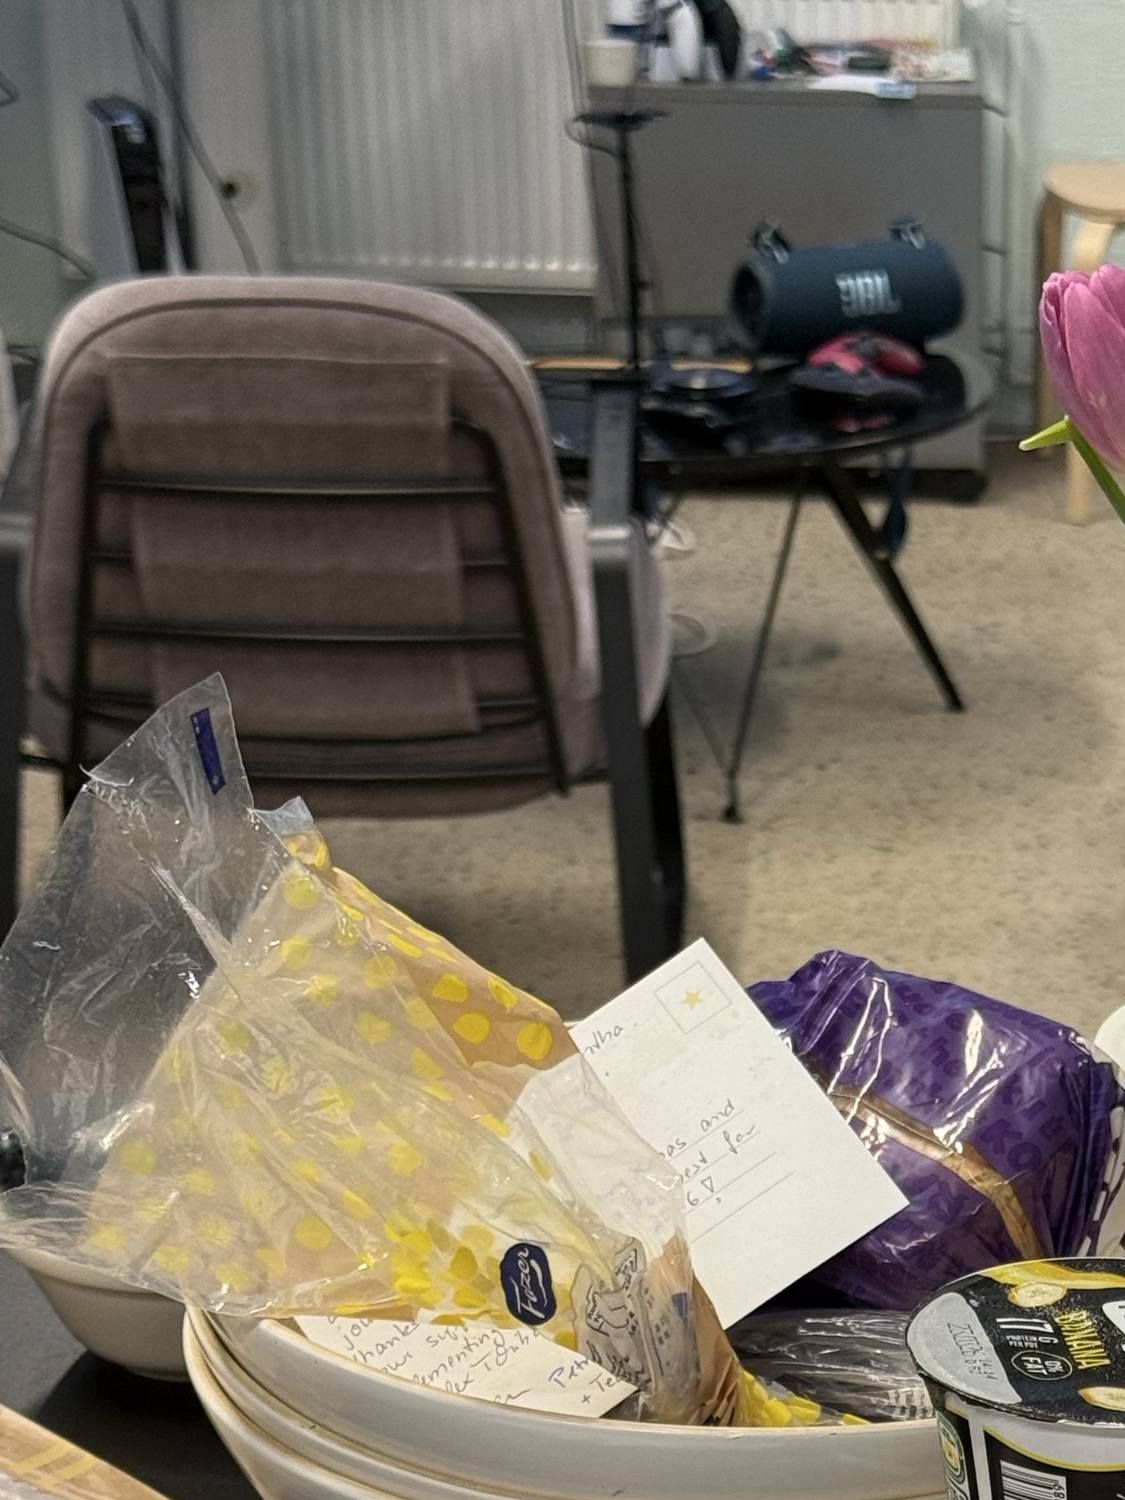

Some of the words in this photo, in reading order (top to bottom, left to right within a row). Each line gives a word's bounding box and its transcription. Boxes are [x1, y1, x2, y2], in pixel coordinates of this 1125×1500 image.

[513, 1246, 547, 1320] Fazer
[996, 1317, 1055, 1333] 17
[1053, 1310, 1111, 1370] BANANA
